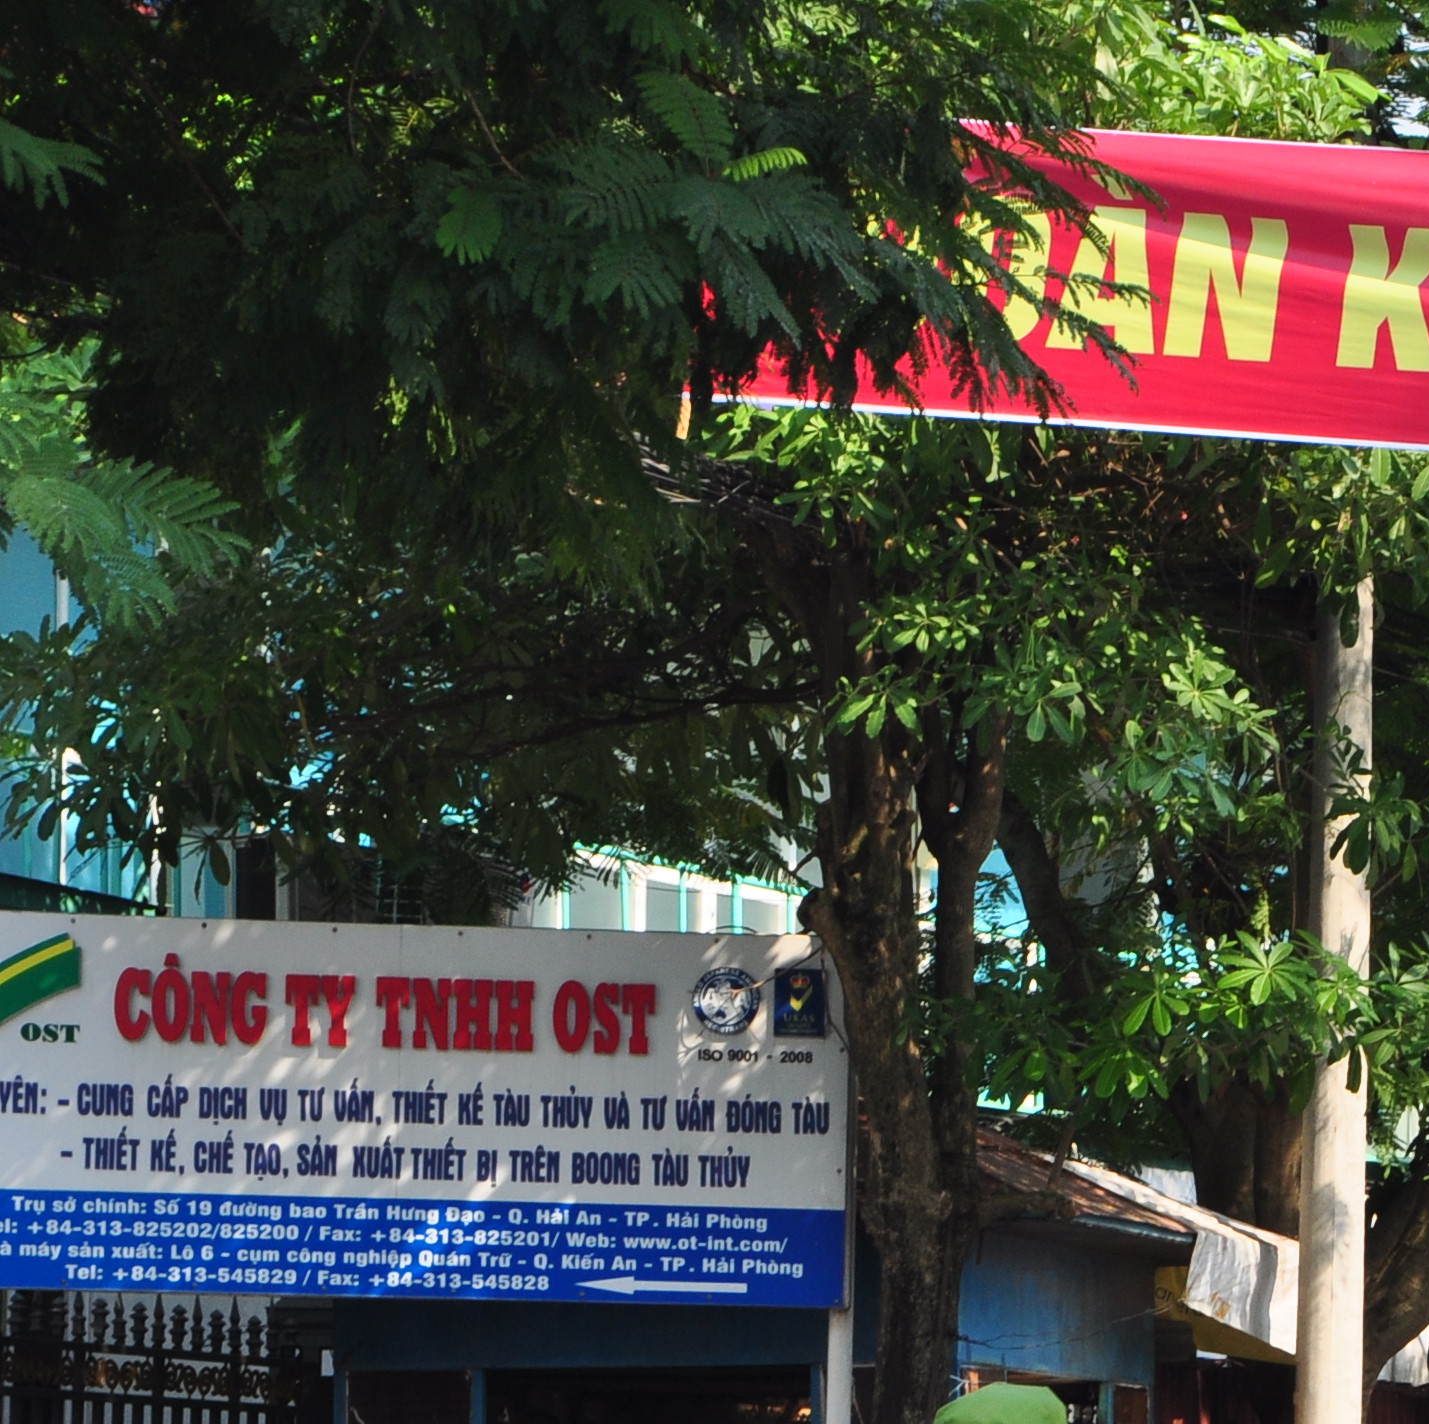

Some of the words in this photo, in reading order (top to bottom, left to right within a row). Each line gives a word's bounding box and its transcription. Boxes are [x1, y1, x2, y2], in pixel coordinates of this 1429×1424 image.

[908, 174, 1287, 362] OÀN
[113, 952, 268, 1046] CÔNG
[285, 973, 356, 1047] TY
[376, 976, 535, 1052] TNHH
[553, 979, 656, 1055] OST
[783, 1012, 815, 1024] UKAS
[20, 1022, 81, 1043] OST
[697, 1048, 723, 1062] ISO
[727, 1049, 759, 1063] 9001
[780, 1050, 813, 1063] 2008
[77, 1082, 134, 1117] CUNG
[147, 1073, 189, 1119] CẤP
[199, 1087, 247, 1125] DỊCH
[260, 1088, 288, 1126] VỤ
[298, 1087, 325, 1122] TƯ
[334, 1078, 382, 1126] VẤN,
[393, 1079, 447, 1125] THIẾT
[458, 1082, 483, 1125] KẾ
[493, 1089, 530, 1127] TÀU
[540, 1085, 593, 1129] THỦY
[604, 1091, 630, 1130] VÀ
[640, 1095, 667, 1131] TƯ
[676, 1087, 715, 1132] VẤN
[726, 1094, 782, 1134] ĐÓNG
[792, 1096, 830, 1135] TÀU
[82, 1126, 140, 1171] THIẾT
[150, 1129, 185, 1175] KẾ,
[194, 1129, 233, 1174] CHẾ
[243, 1143, 289, 1181] TẠO,
[297, 1135, 337, 1177] SẢN
[352, 1135, 406, 1179] XUẤT
[411, 1137, 466, 1181] THIẾT
[476, 1149, 498, 1187] BỊ
[509, 1145, 560, 1184] TRÊN
[571, 1152, 640, 1185] BOONG
[652, 1148, 689, 1187] TÀU
[698, 1146, 750, 1188] THỦY
[12, 1195, 46, 1215] Trụ
[52, 1198, 76, 1213] sở
[83, 1198, 148, 1215] chính:
[153, 1197, 179, 1215] Số
[188, 1200, 212, 1216] 19
[219, 1200, 282, 1220] đường
[289, 1203, 327, 1219] bao
[334, 1203, 379, 1220] Trần
[387, 1204, 438, 1225] Hưng
[445, 1207, 485, 1227] Đạo
[508, 1209, 529, 1225] Q.
[536, 1207, 569, 1225] Hải
[576, 1210, 602, 1226] An
[666, 1211, 700, 1229] Hải
[706, 1213, 768, 1232] Phòng
[27, 1219, 299, 1241] +84-313-825202/825200
[319, 1226, 362, 1242] Fax:
[566, 1231, 616, 1248] Web:
[624, 1234, 788, 1254] www.ot-int.com/
[19, 1244, 61, 1261] máy
[68, 1243, 105, 1259] sản
[111, 1243, 163, 1260] xuất:
[171, 1244, 194, 1261] Lô
[201, 1247, 214, 1262] 6
[237, 1251, 280, 1266] cụm
[289, 1250, 336, 1268] công
[342, 1250, 412, 1270] nghiệp
[534, 1254, 554, 1271] Q.
[561, 1253, 604, 1271] Kiến
[611, 1256, 637, 1271] An
[702, 1257, 735, 1274] Hải
[741, 1258, 803, 1278] Phòng
[65, 1263, 103, 1280] Tel:
[112, 1266, 297, 1285] +84-313-545829
[318, 1270, 360, 1286] Fax:
[369, 1271, 549, 1291] +84-313-545828
